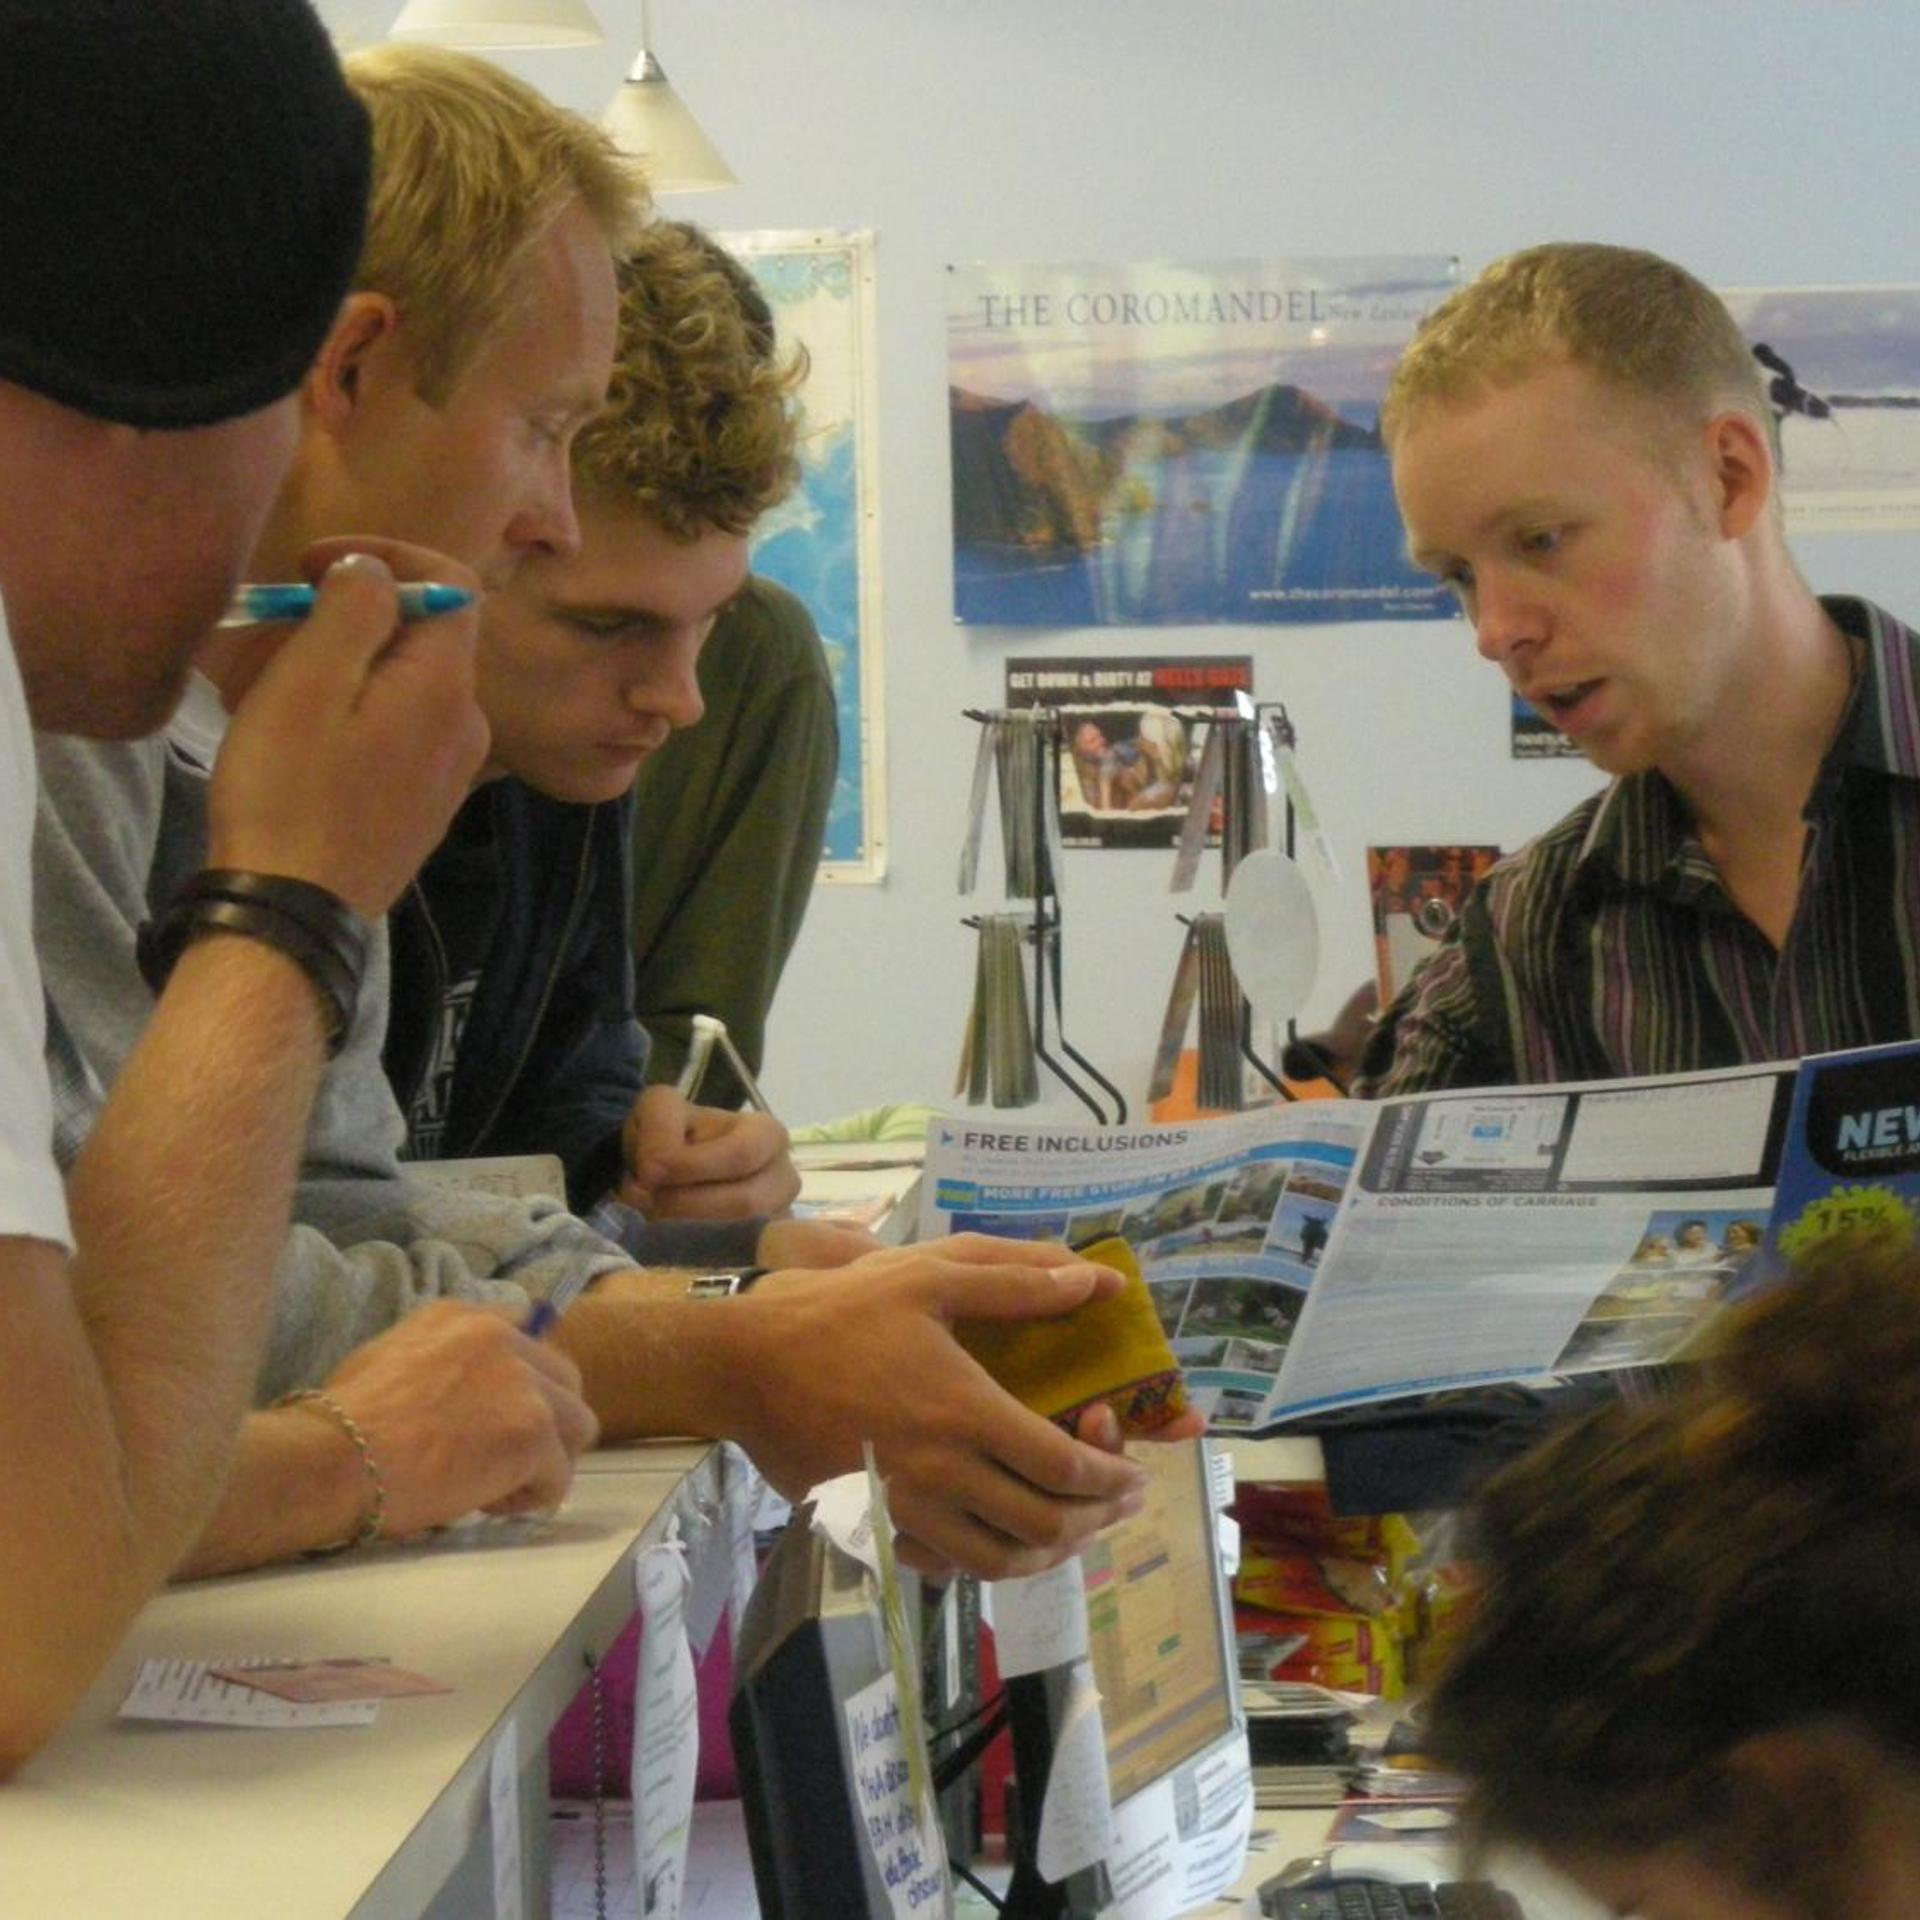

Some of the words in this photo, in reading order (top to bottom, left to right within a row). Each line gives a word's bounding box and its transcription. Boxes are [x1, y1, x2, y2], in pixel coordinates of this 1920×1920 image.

[977, 294, 1050, 328] THE
[1066, 289, 1326, 326] COROMANDEL
[1009, 672, 1034, 688] GET
[1037, 672, 1079, 688] DOWN
[1094, 671, 1133, 688] DIRTY
[1135, 671, 1153, 688] AT
[963, 1132, 1029, 1151] FREE
[1037, 1130, 1188, 1153] INCLUSIONS
[983, 1186, 1034, 1200] MORE
[1039, 1185, 1082, 1199] FREE
[1377, 1197, 1481, 1208] CONDITIONS
[1486, 1197, 1508, 1208] OF
[1513, 1196, 1598, 1207] CARRIAGE
